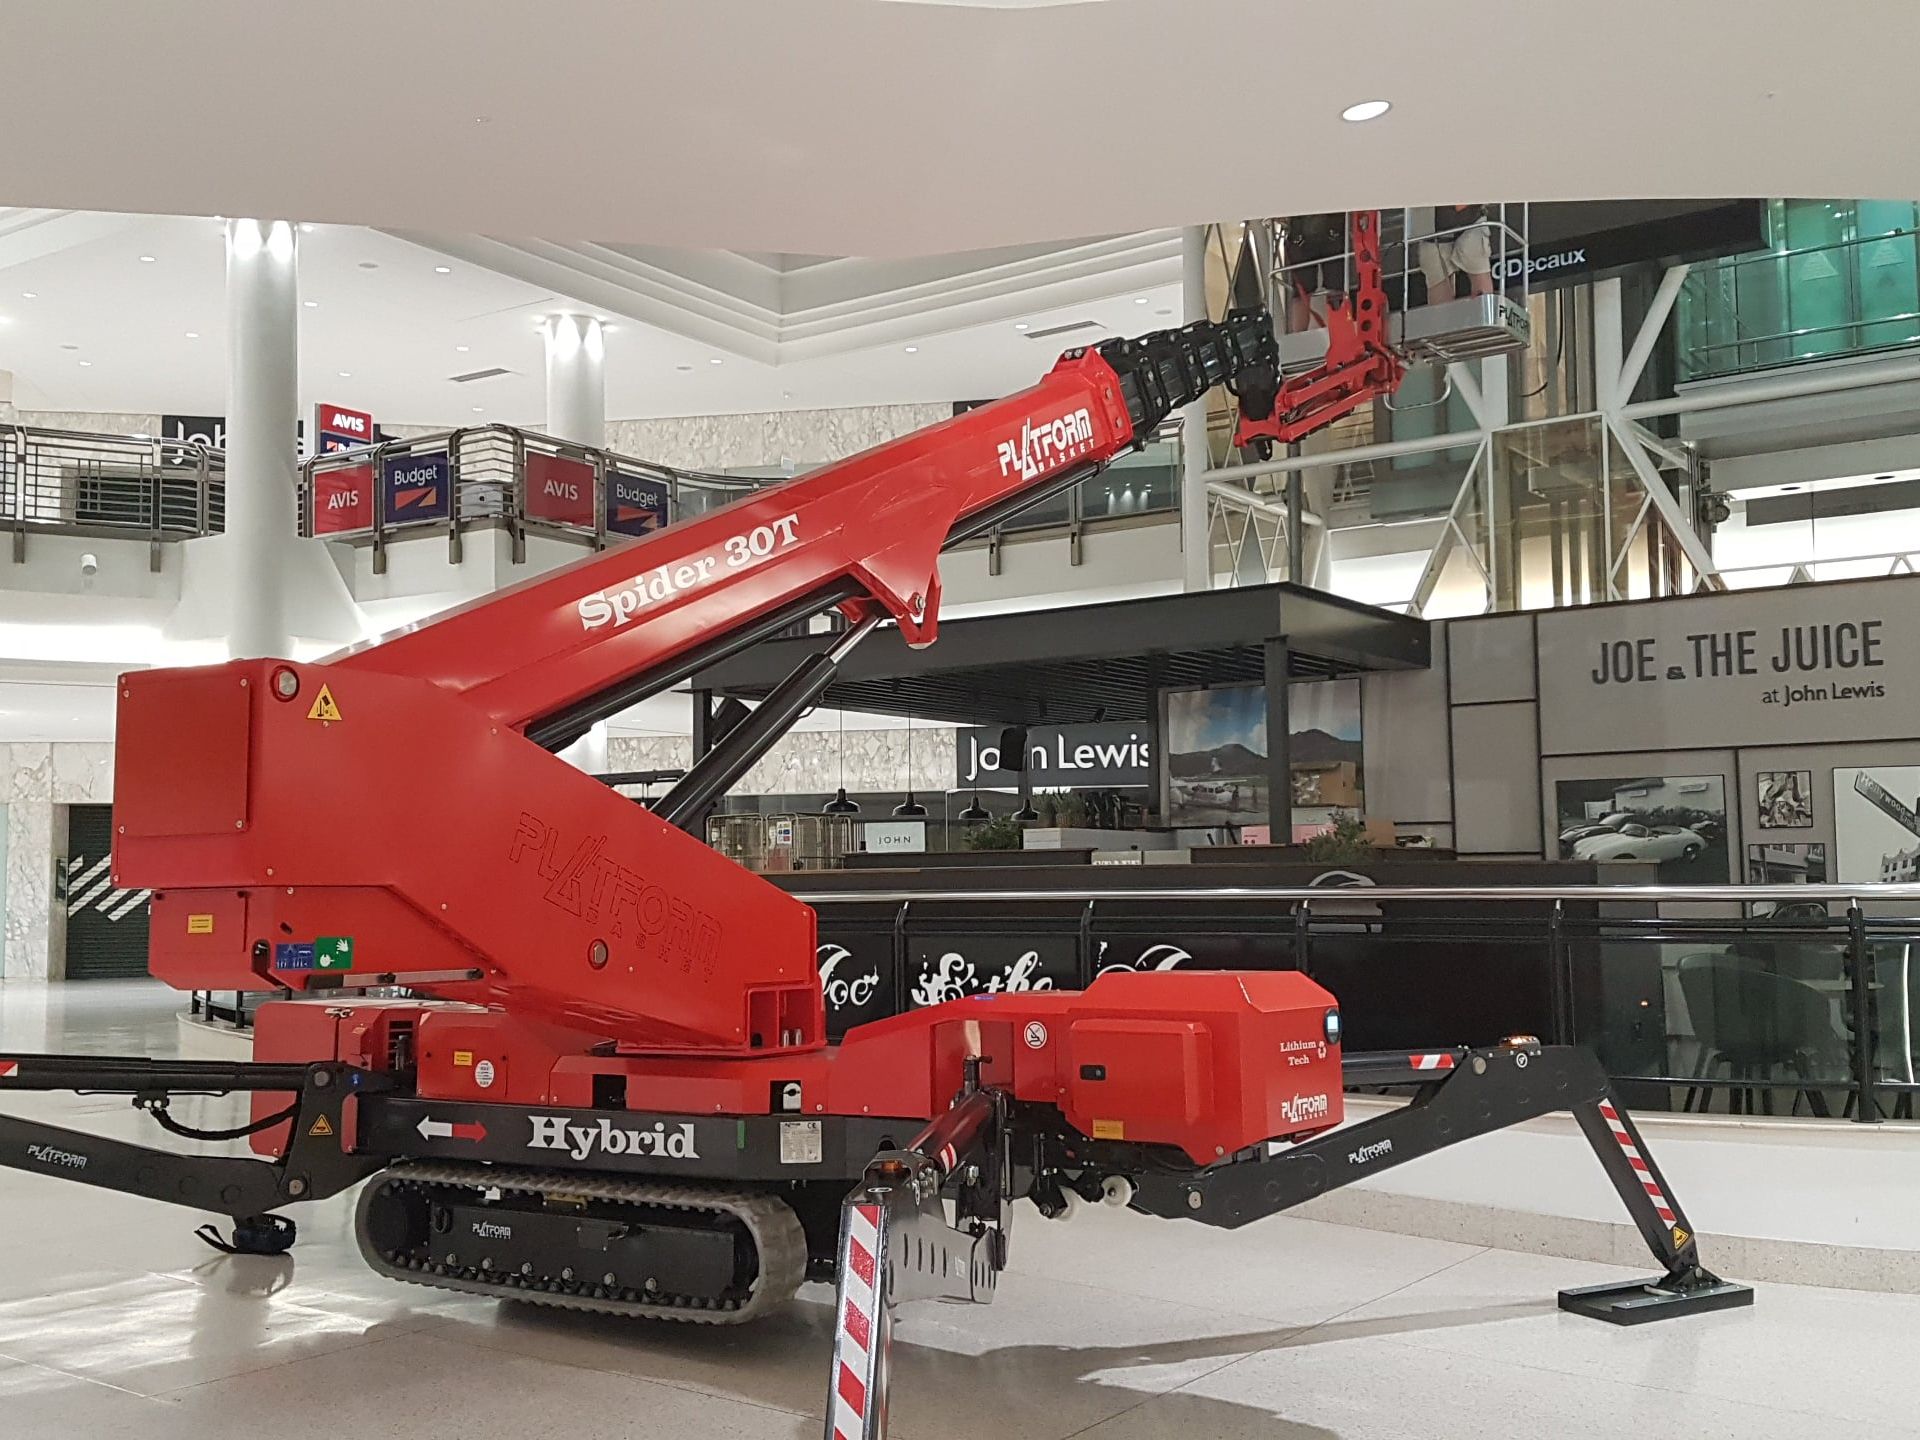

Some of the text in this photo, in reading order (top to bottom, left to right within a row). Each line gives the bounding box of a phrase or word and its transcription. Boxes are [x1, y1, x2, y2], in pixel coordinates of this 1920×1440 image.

[332, 413, 365, 432] AVIS
[997, 407, 1093, 481] PLATFORM
[1038, 438, 1095, 473] BASKET
[394, 464, 438, 487] Budget
[327, 490, 360, 510] AVIS
[543, 479, 579, 500] AVIS
[616, 483, 658, 508] Budget
[577, 513, 800, 632] Spider 30T
[1592, 620, 1885, 685] JOE & THE JUICE
[1762, 681, 1885, 707] at John Lewis
[965, 733, 1149, 782] Jon Lewis
[878, 835, 912, 845] JOHN
[509, 811, 723, 962] PLATFORM
[1280, 1040, 1317, 1053] Lithium
[1288, 1054, 1310, 1067] Tech
[1281, 1092, 1328, 1123] PLATFORM
[526, 1115, 701, 1161] Hybrid
[27, 1144, 88, 1169] PLATFORM
[1348, 1139, 1393, 1164] PLATFORM
[472, 1221, 511, 1237] PLATFORM
